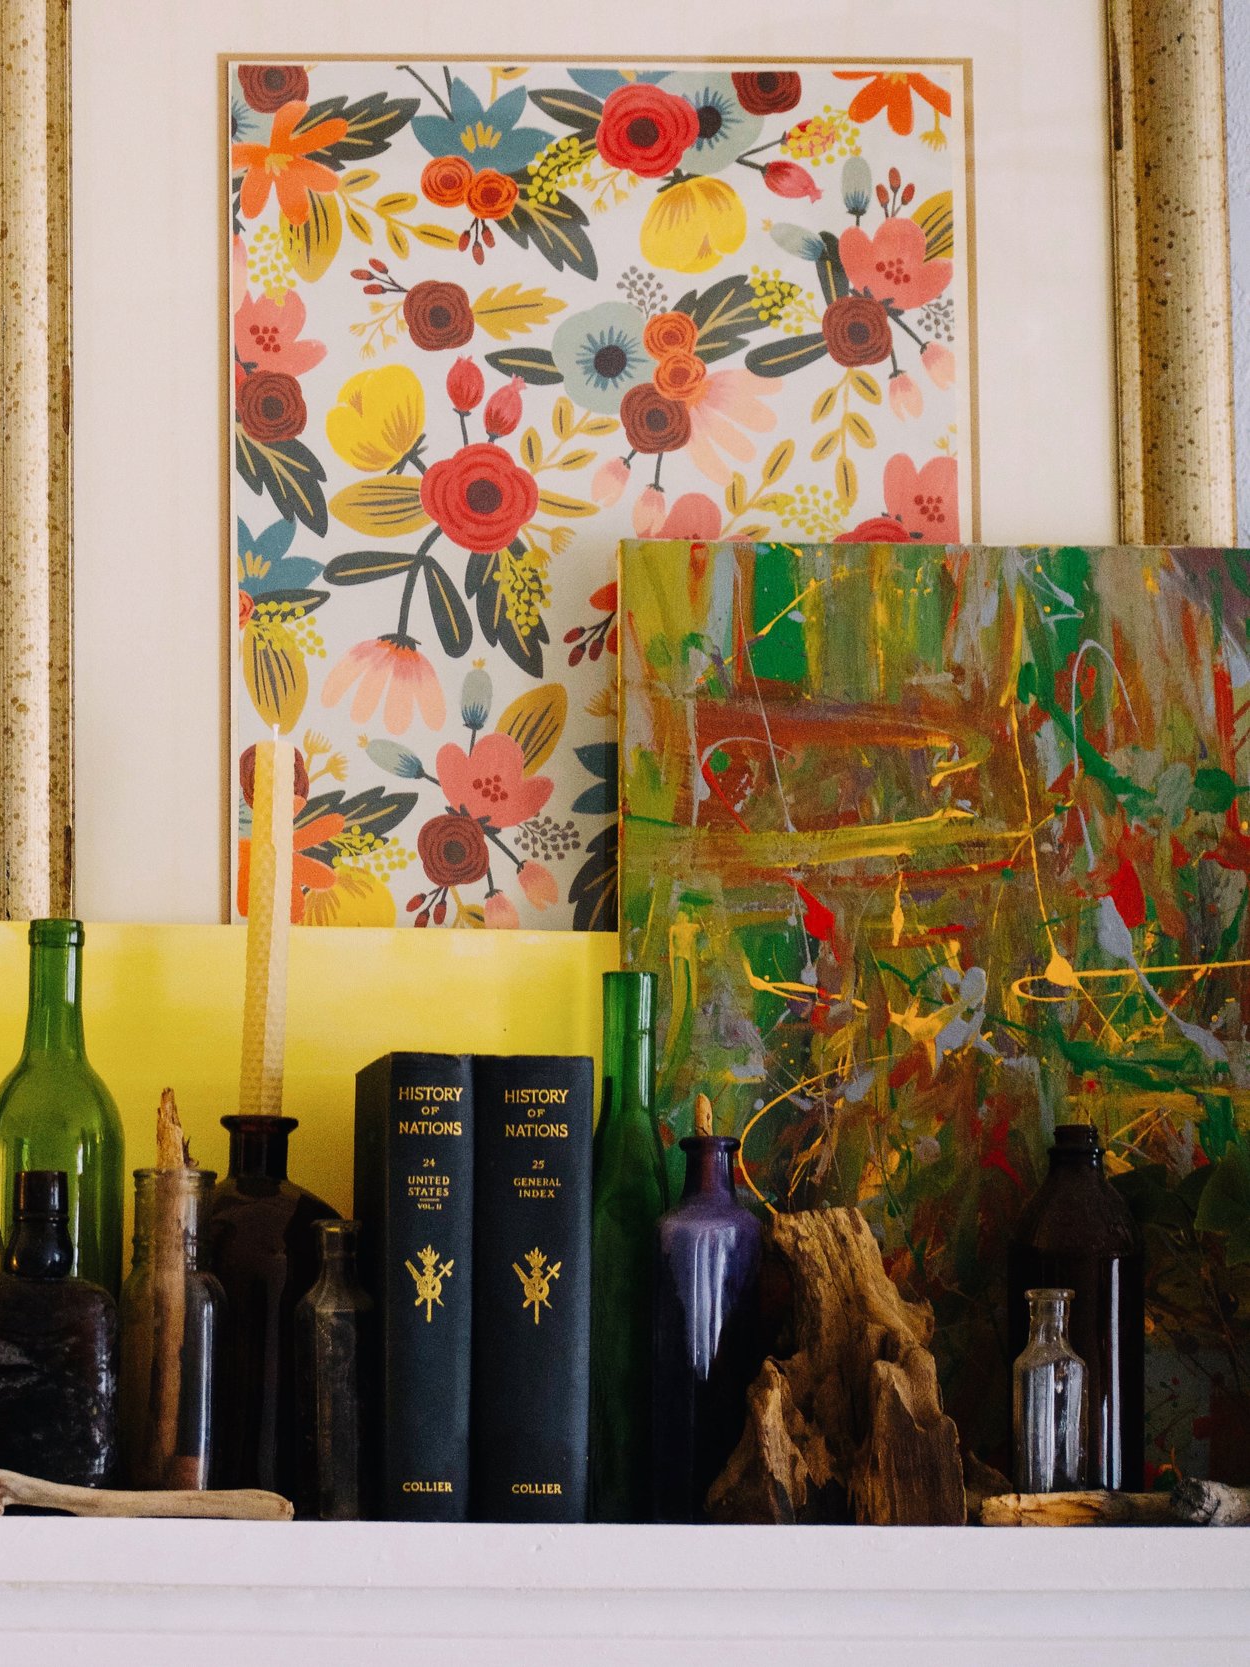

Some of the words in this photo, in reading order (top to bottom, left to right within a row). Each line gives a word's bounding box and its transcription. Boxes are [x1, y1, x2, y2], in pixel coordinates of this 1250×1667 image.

[399, 1086, 463, 1102] HISTORY
[505, 1089, 569, 1104] HISTORY
[421, 1106, 440, 1116] OF
[527, 1108, 546, 1118] OF
[399, 1121, 462, 1136] NATIONS
[505, 1123, 569, 1138] NATIONS
[423, 1158, 436, 1168] 24
[531, 1159, 545, 1170] 25
[408, 1175, 450, 1186] UNITED
[513, 1177, 561, 1188] GENERAL
[408, 1187, 449, 1197] STATES
[519, 1189, 555, 1198] INDEX
[402, 1481, 453, 1492] COLLIER
[511, 1483, 562, 1495] COLLIER
